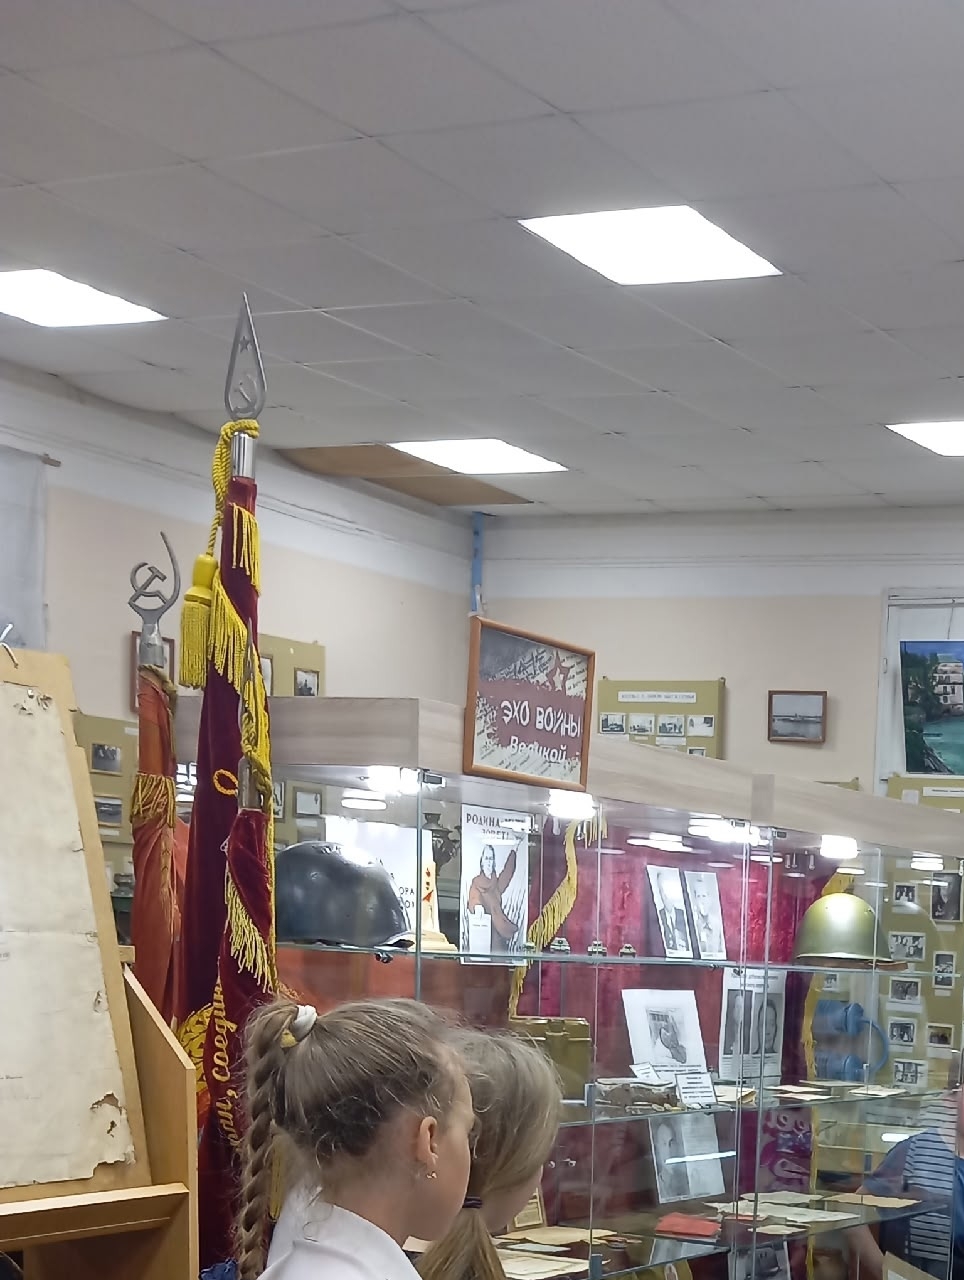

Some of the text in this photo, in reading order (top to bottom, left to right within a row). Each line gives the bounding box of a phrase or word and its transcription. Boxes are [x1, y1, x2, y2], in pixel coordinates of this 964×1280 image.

[501, 700, 581, 738] ЭХО ВОЙНЫ
[212, 979, 238, 1082] соедин
